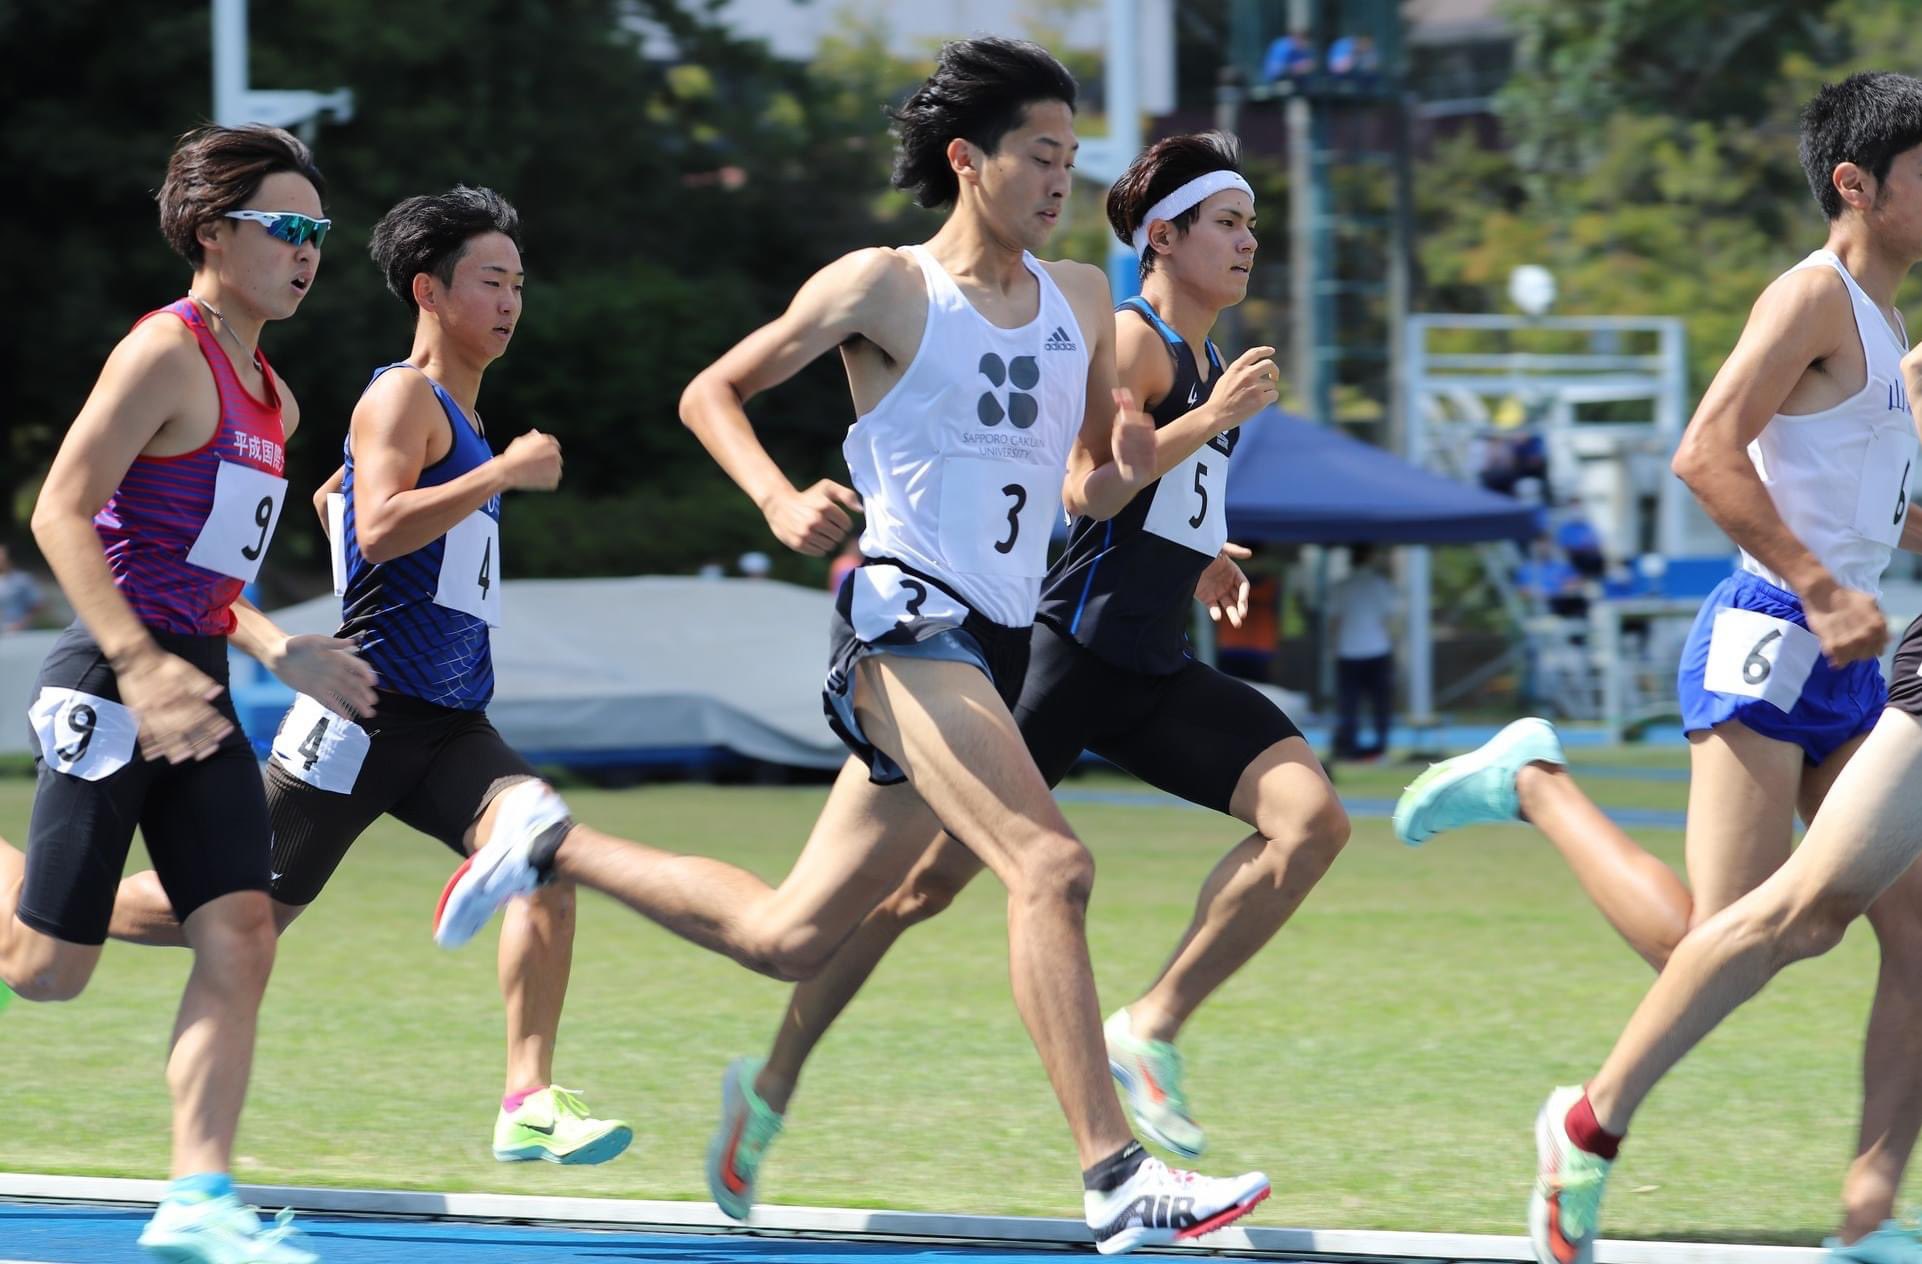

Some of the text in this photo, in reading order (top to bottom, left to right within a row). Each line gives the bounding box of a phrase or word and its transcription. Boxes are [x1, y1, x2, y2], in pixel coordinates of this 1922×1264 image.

[963, 432, 1008, 445] SAPPORO
[980, 446, 1032, 459] UNIVERSITY
[994, 483, 1027, 554] 3
[1188, 462, 1208, 530] 5
[1893, 459, 1910, 525] 6
[241, 496, 273, 561] 9
[477, 536, 491, 600] 4
[1743, 628, 1782, 686] 6
[57, 703, 97, 763] 9
[300, 717, 331, 771] 4
[1114, 1194, 1199, 1231] AIR
